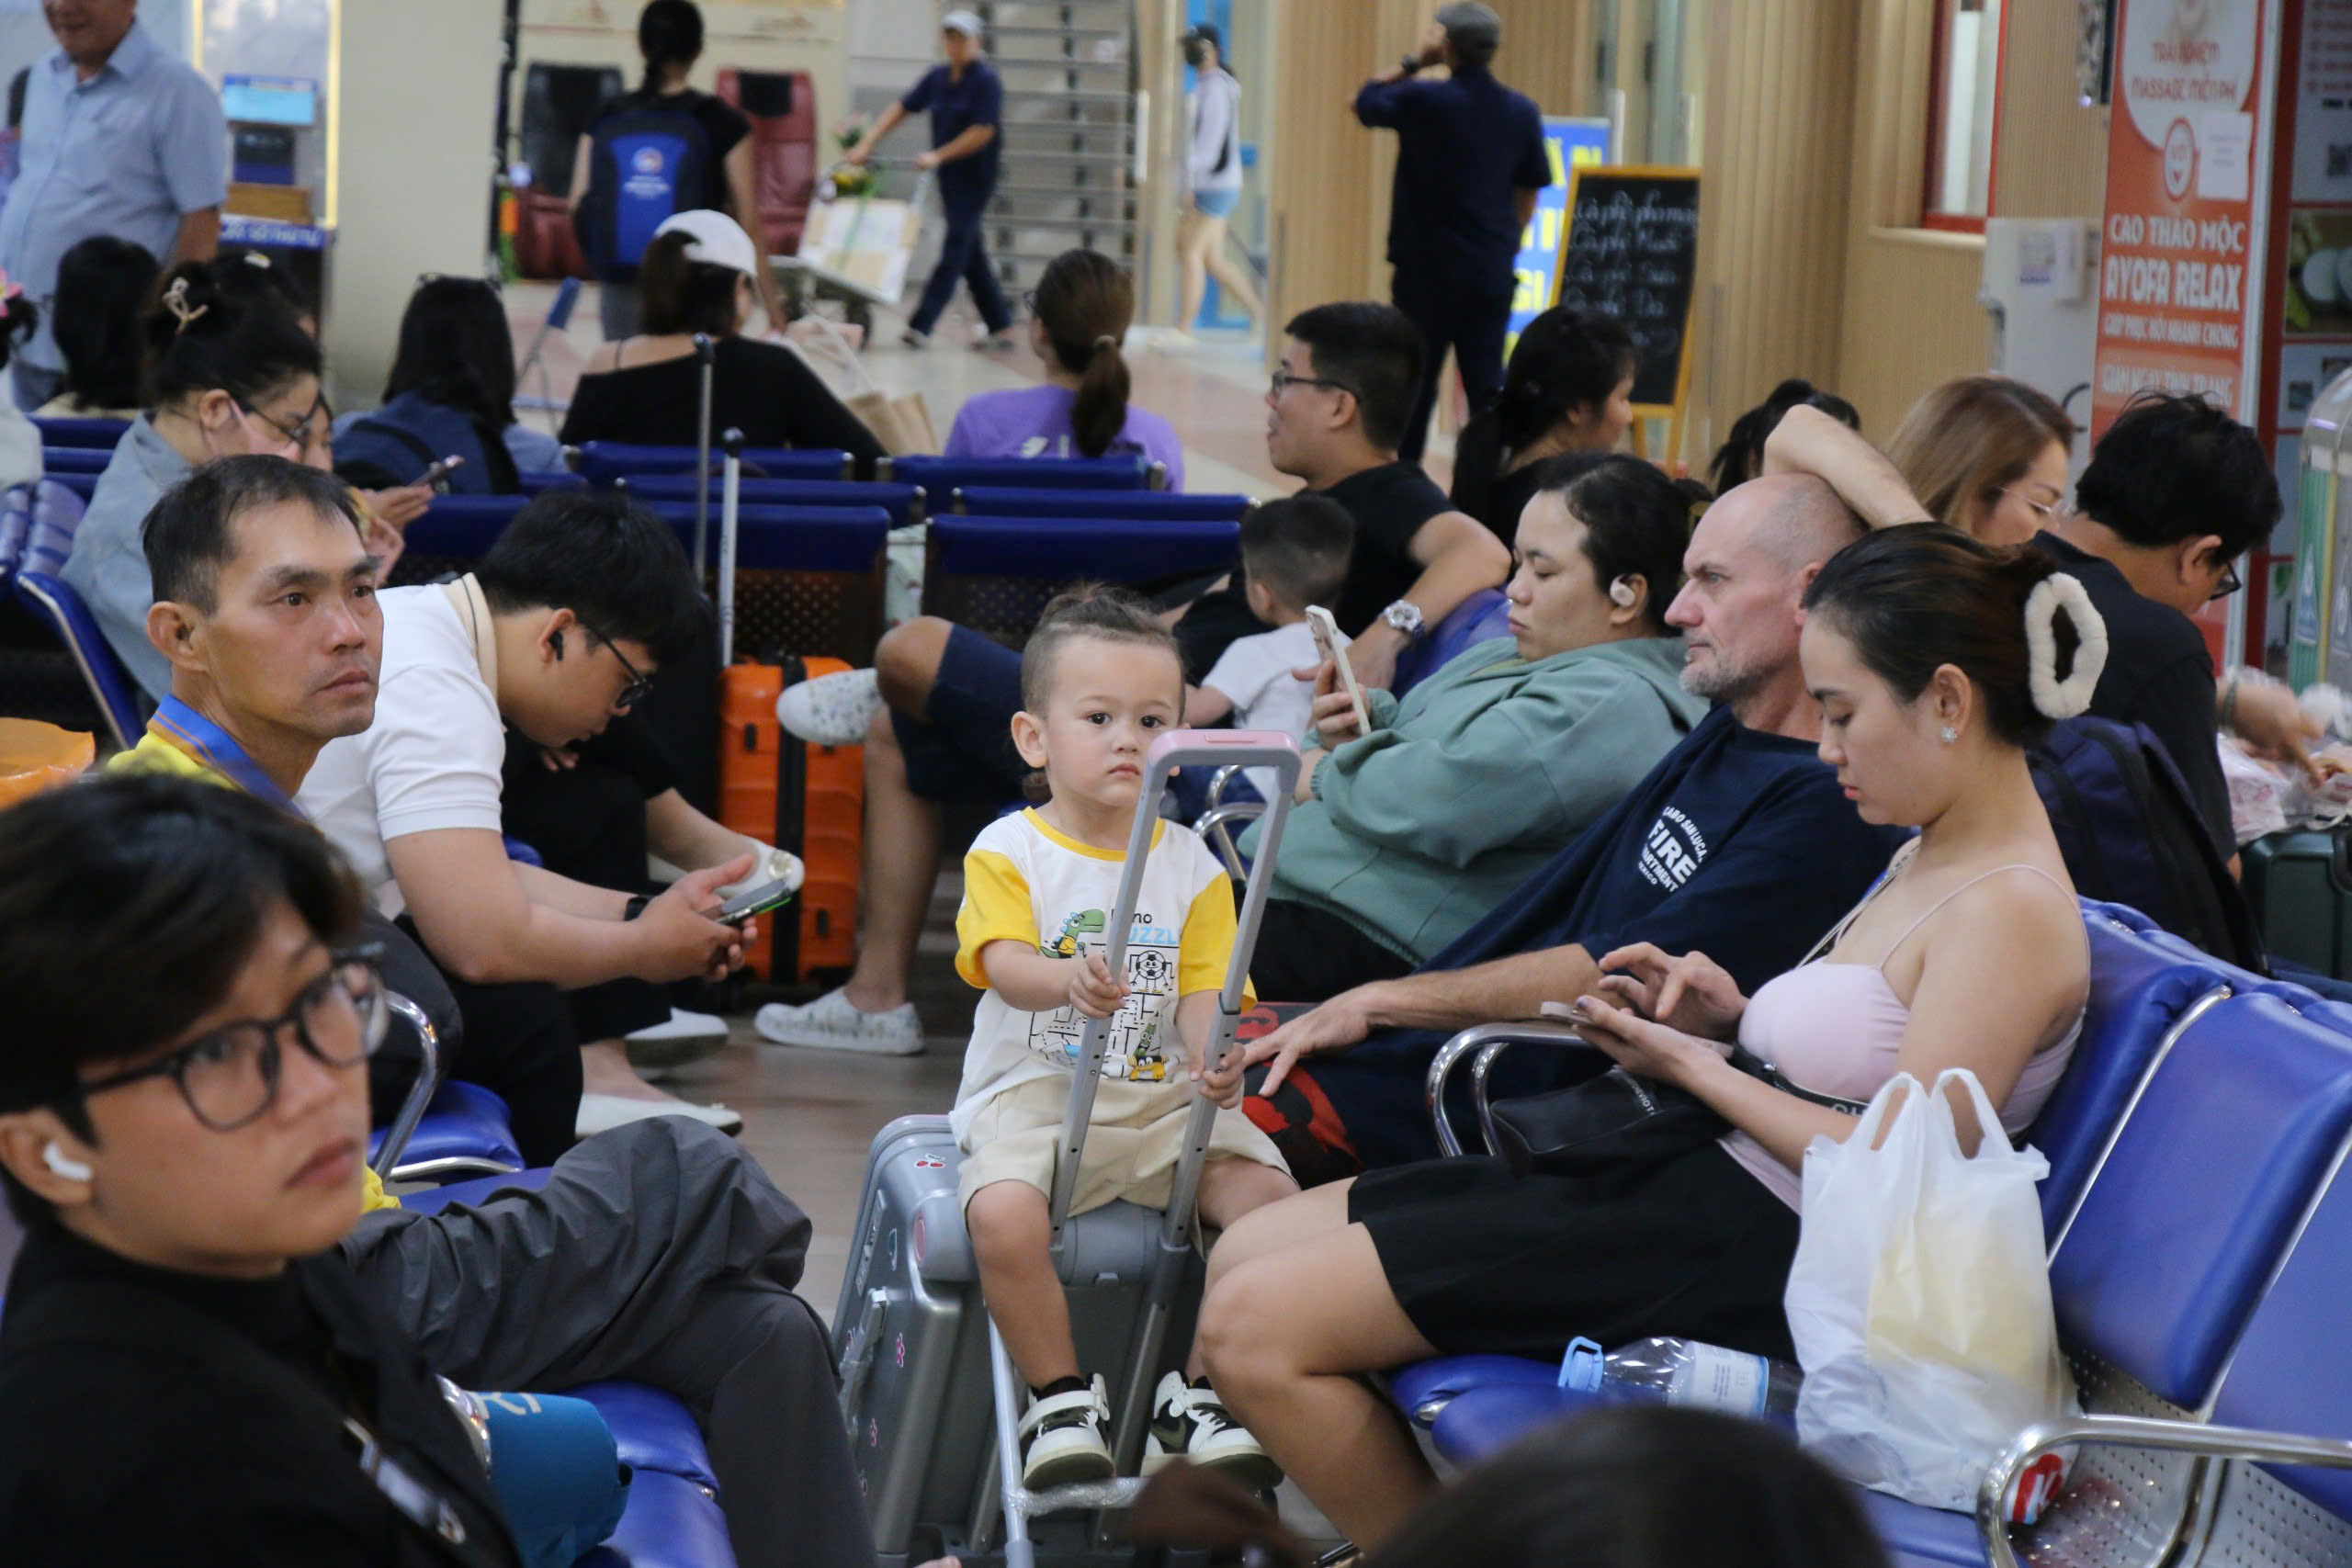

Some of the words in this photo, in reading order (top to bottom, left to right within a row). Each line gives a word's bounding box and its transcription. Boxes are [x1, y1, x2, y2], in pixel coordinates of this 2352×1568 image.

[2109, 212, 2144, 245] CAO
[2199, 213, 2246, 257] MỘC
[2174, 259, 2242, 311] RELAX
[1647, 818, 1698, 885] FIRE
